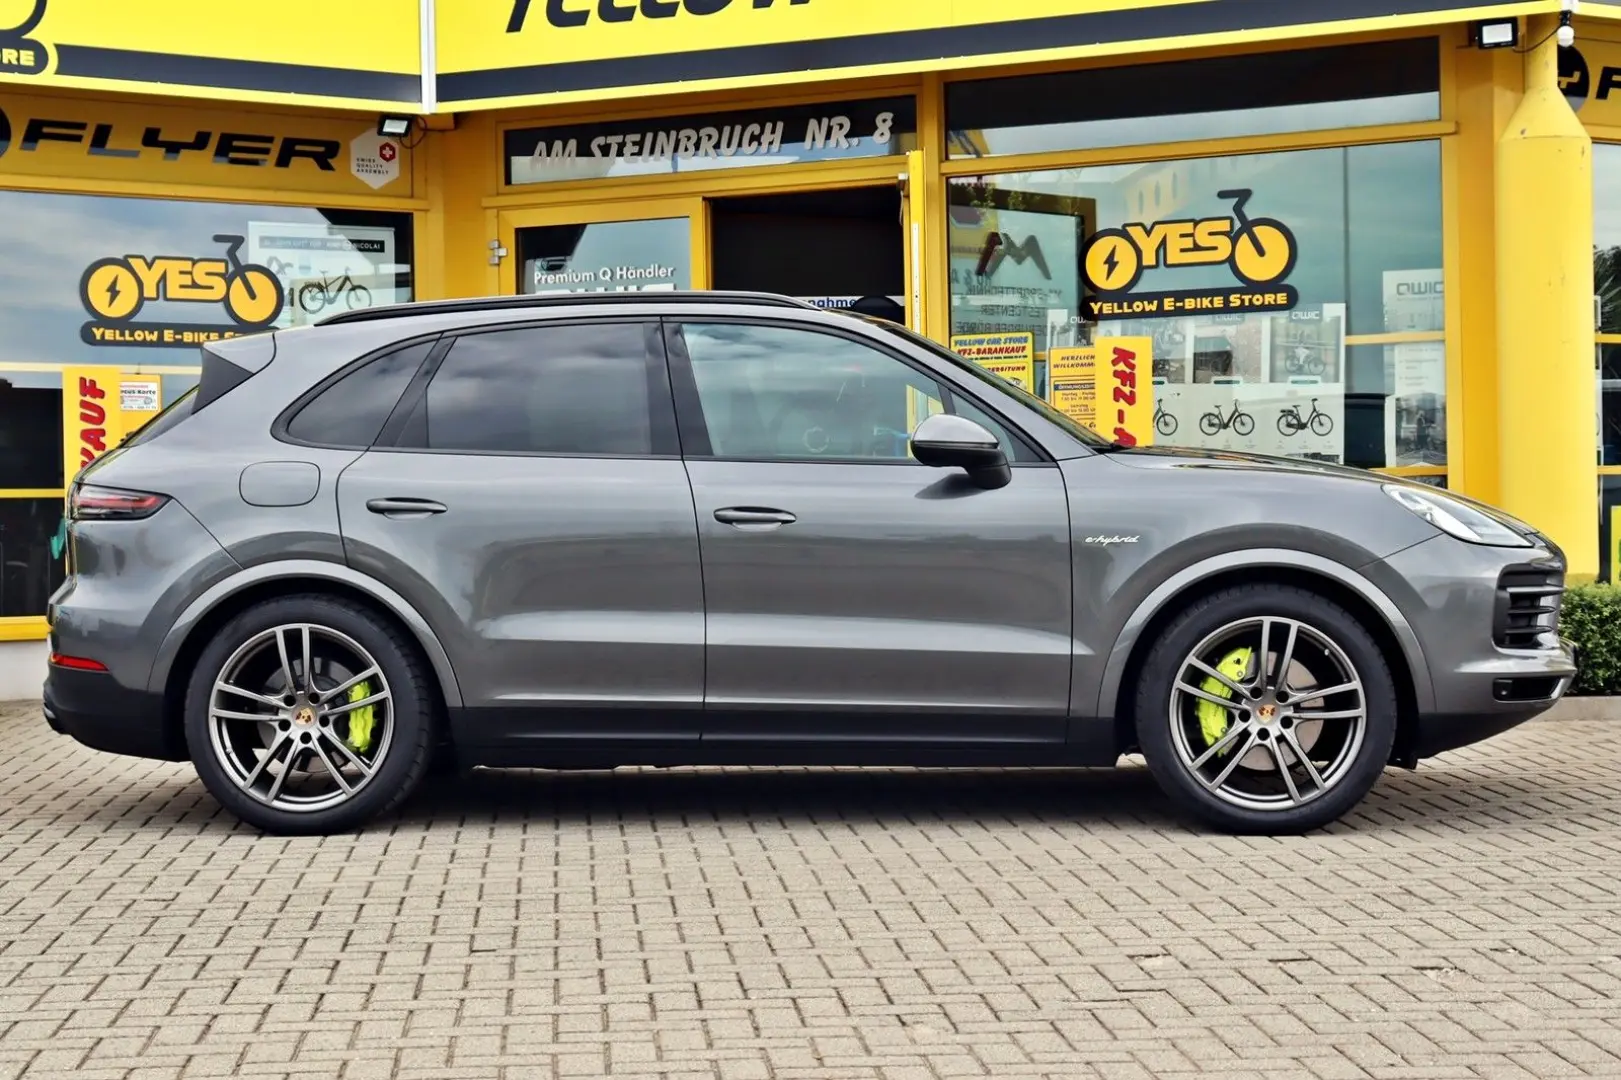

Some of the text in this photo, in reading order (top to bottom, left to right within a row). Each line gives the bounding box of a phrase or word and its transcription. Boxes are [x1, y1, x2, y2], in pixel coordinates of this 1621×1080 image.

[0, 48, 35, 67] RE
[19, 118, 341, 172] FLYER
[530, 111, 894, 163] AM STEINBRUCH NR. 8
[1124, 217, 1234, 267] YES
[125, 255, 229, 302] YES
[533, 263, 675, 285] Premium Q Händler
[1089, 292, 1288, 314] YELLOW E-BIKE STORE
[92, 327, 158, 342] YELLOW
[163, 331, 219, 343] E-BIKE
[954, 336, 1028, 347] YELLOW CAR STORE
